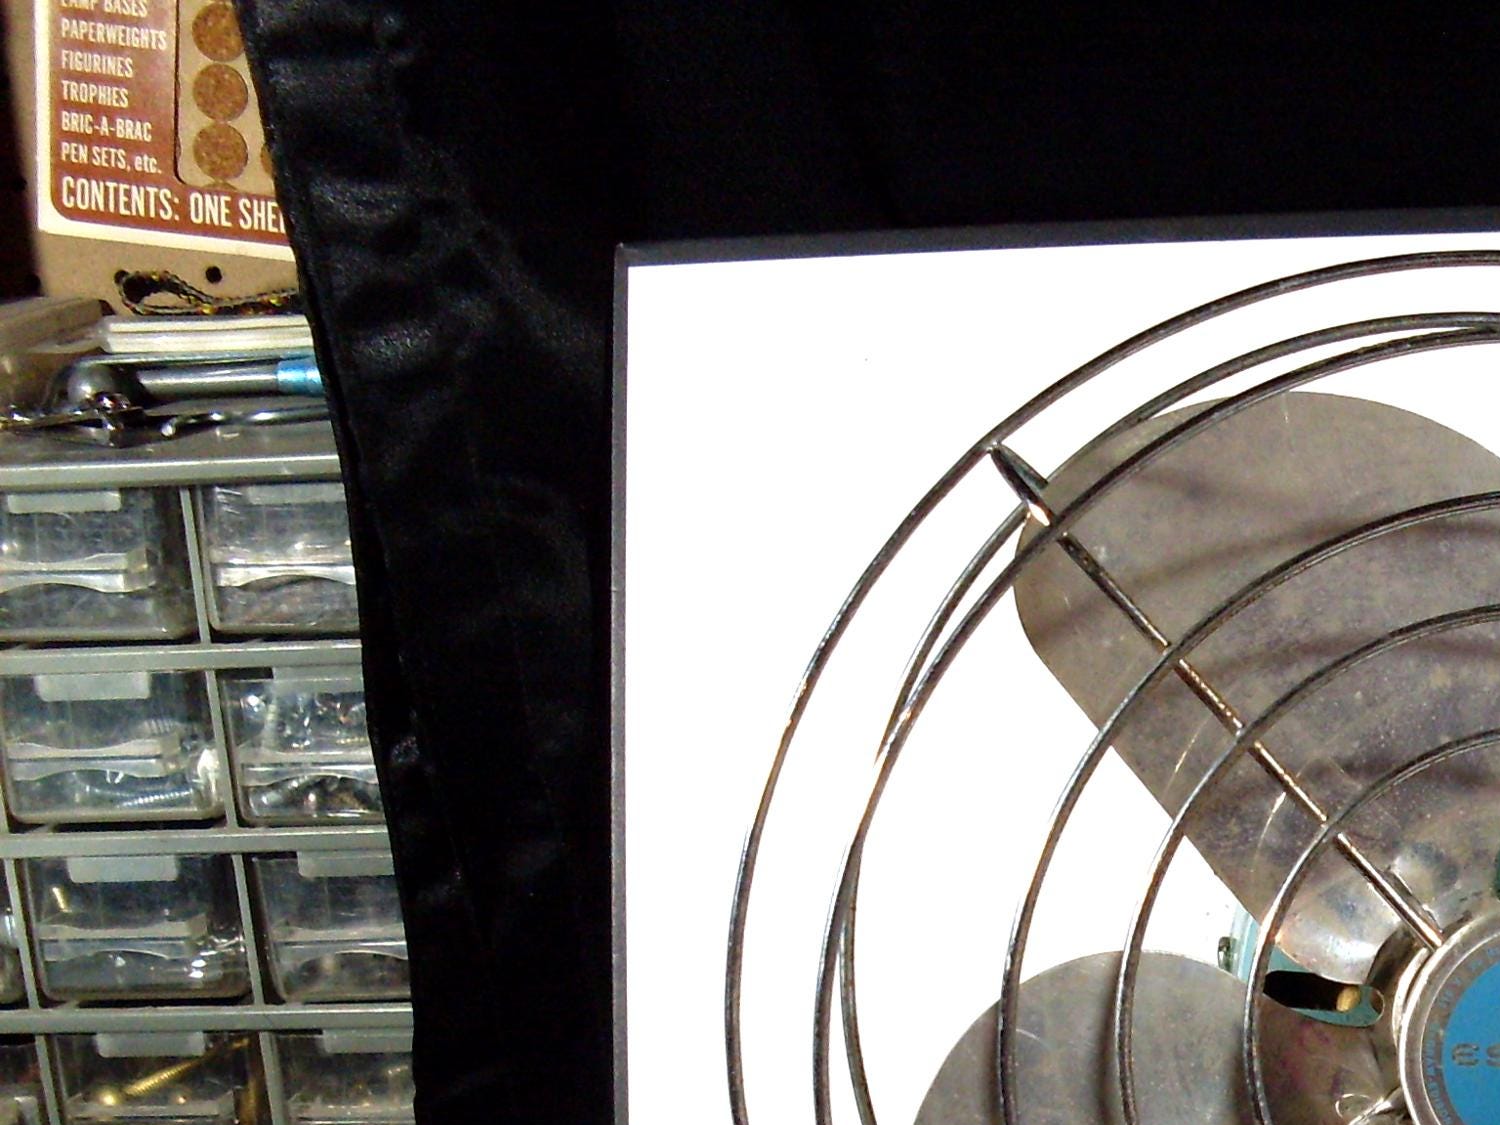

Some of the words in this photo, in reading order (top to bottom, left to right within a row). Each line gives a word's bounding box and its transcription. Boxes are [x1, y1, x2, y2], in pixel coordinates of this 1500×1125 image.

[104, 0, 148, 18] BASES
[61, 17, 168, 50] PAPERWEIGHTS
[61, 49, 134, 79] FIGURINES
[61, 80, 129, 108] TROPHIES
[61, 110, 152, 143] BRIC-A-BRAC
[61, 142, 88, 164] PEN
[92, 145, 131, 173] SETS,
[133, 156, 163, 175] etc.
[61, 175, 180, 221] CONTENTS:
[190, 192, 232, 228] ONE
